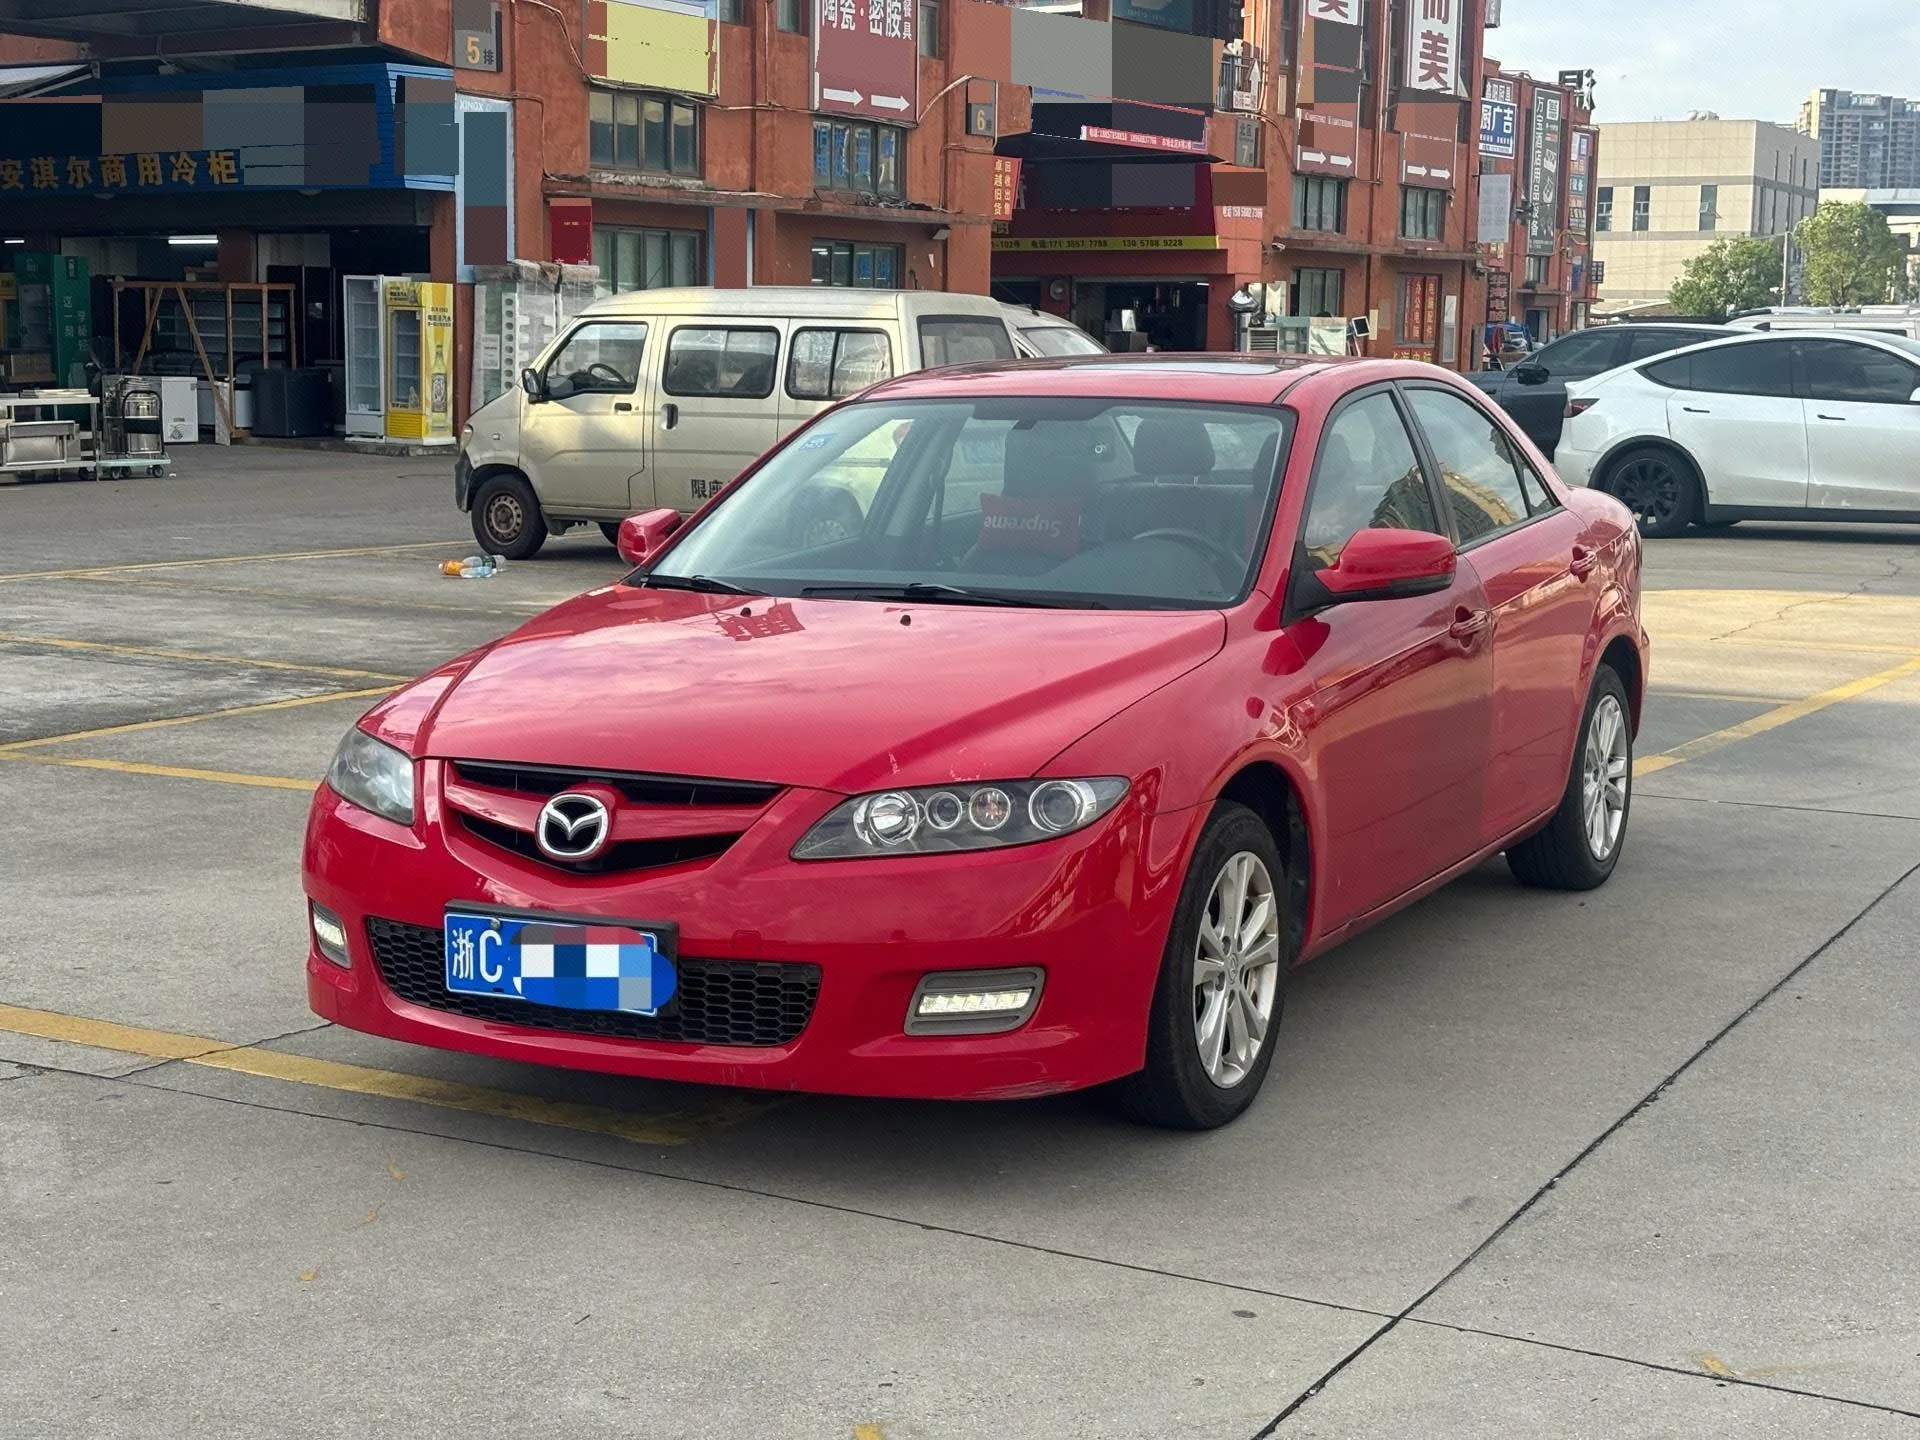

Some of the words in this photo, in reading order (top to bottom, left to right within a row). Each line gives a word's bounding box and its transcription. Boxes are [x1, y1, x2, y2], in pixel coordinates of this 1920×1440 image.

[0, 151, 240, 190] 安淇尔商用冷柜
[984, 513, 1062, 538] Supreme
[452, 928, 503, 983] 浙C
